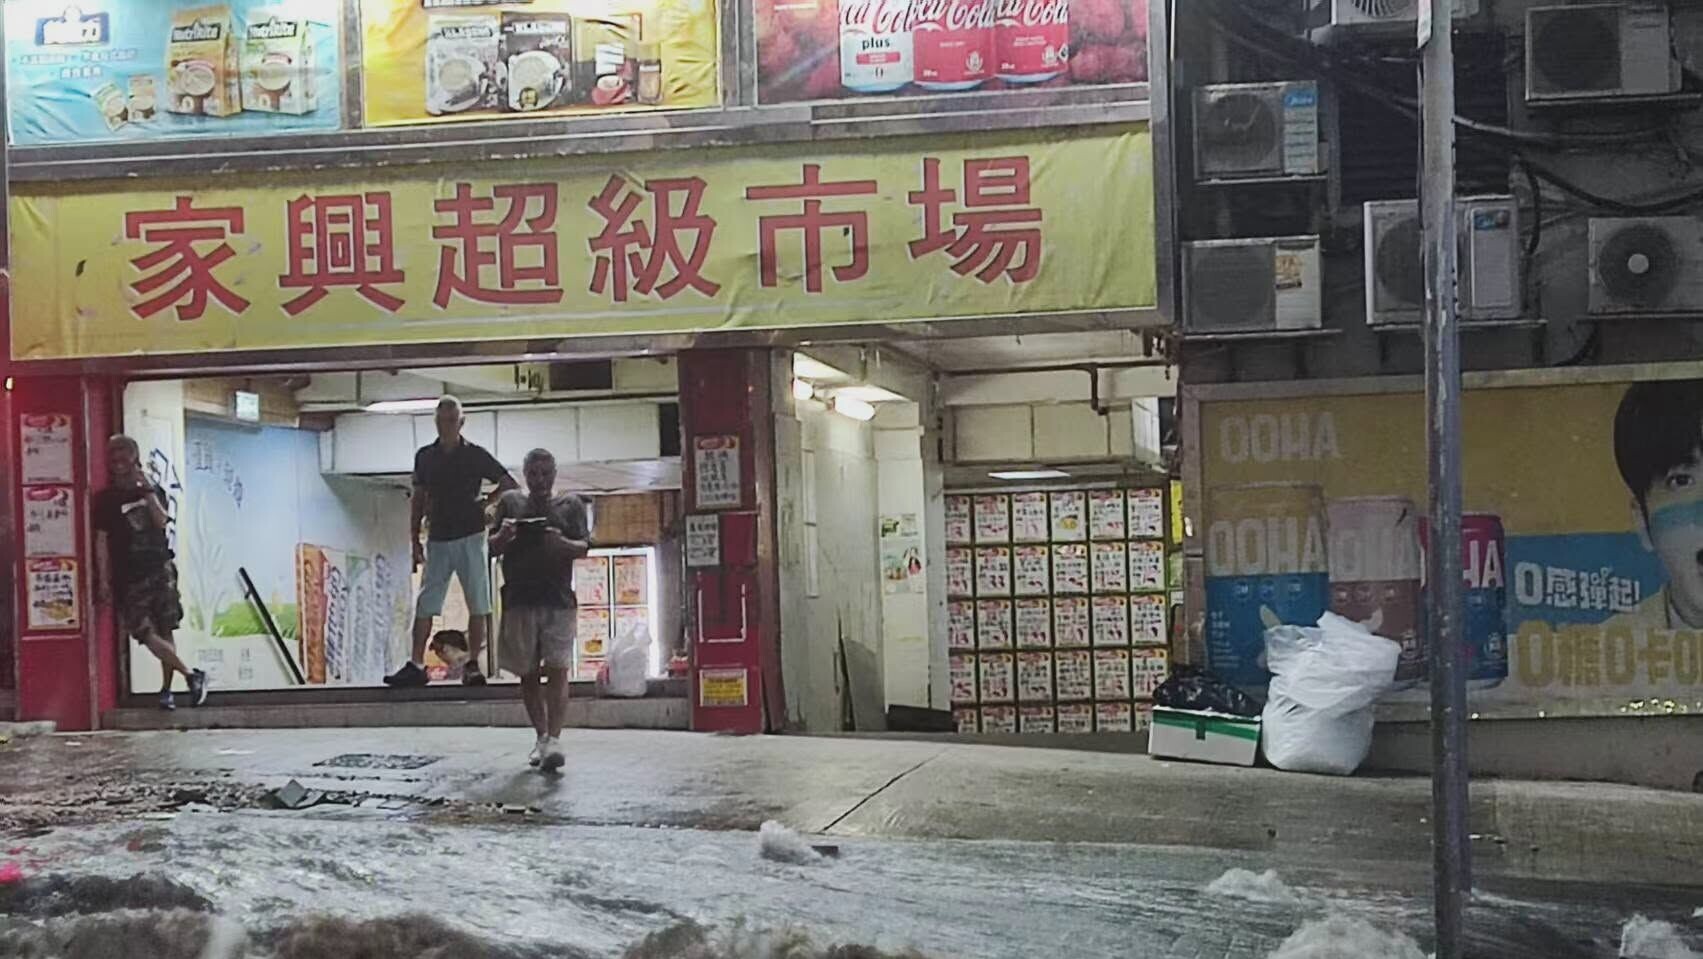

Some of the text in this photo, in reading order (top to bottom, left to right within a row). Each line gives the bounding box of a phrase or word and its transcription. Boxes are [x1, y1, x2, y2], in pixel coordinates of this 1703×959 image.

[861, 36, 891, 51] plus
[124, 155, 1043, 321] 家興超級市場
[1219, 412, 1342, 464] OOHA
[1208, 515, 1328, 577] OOHA
